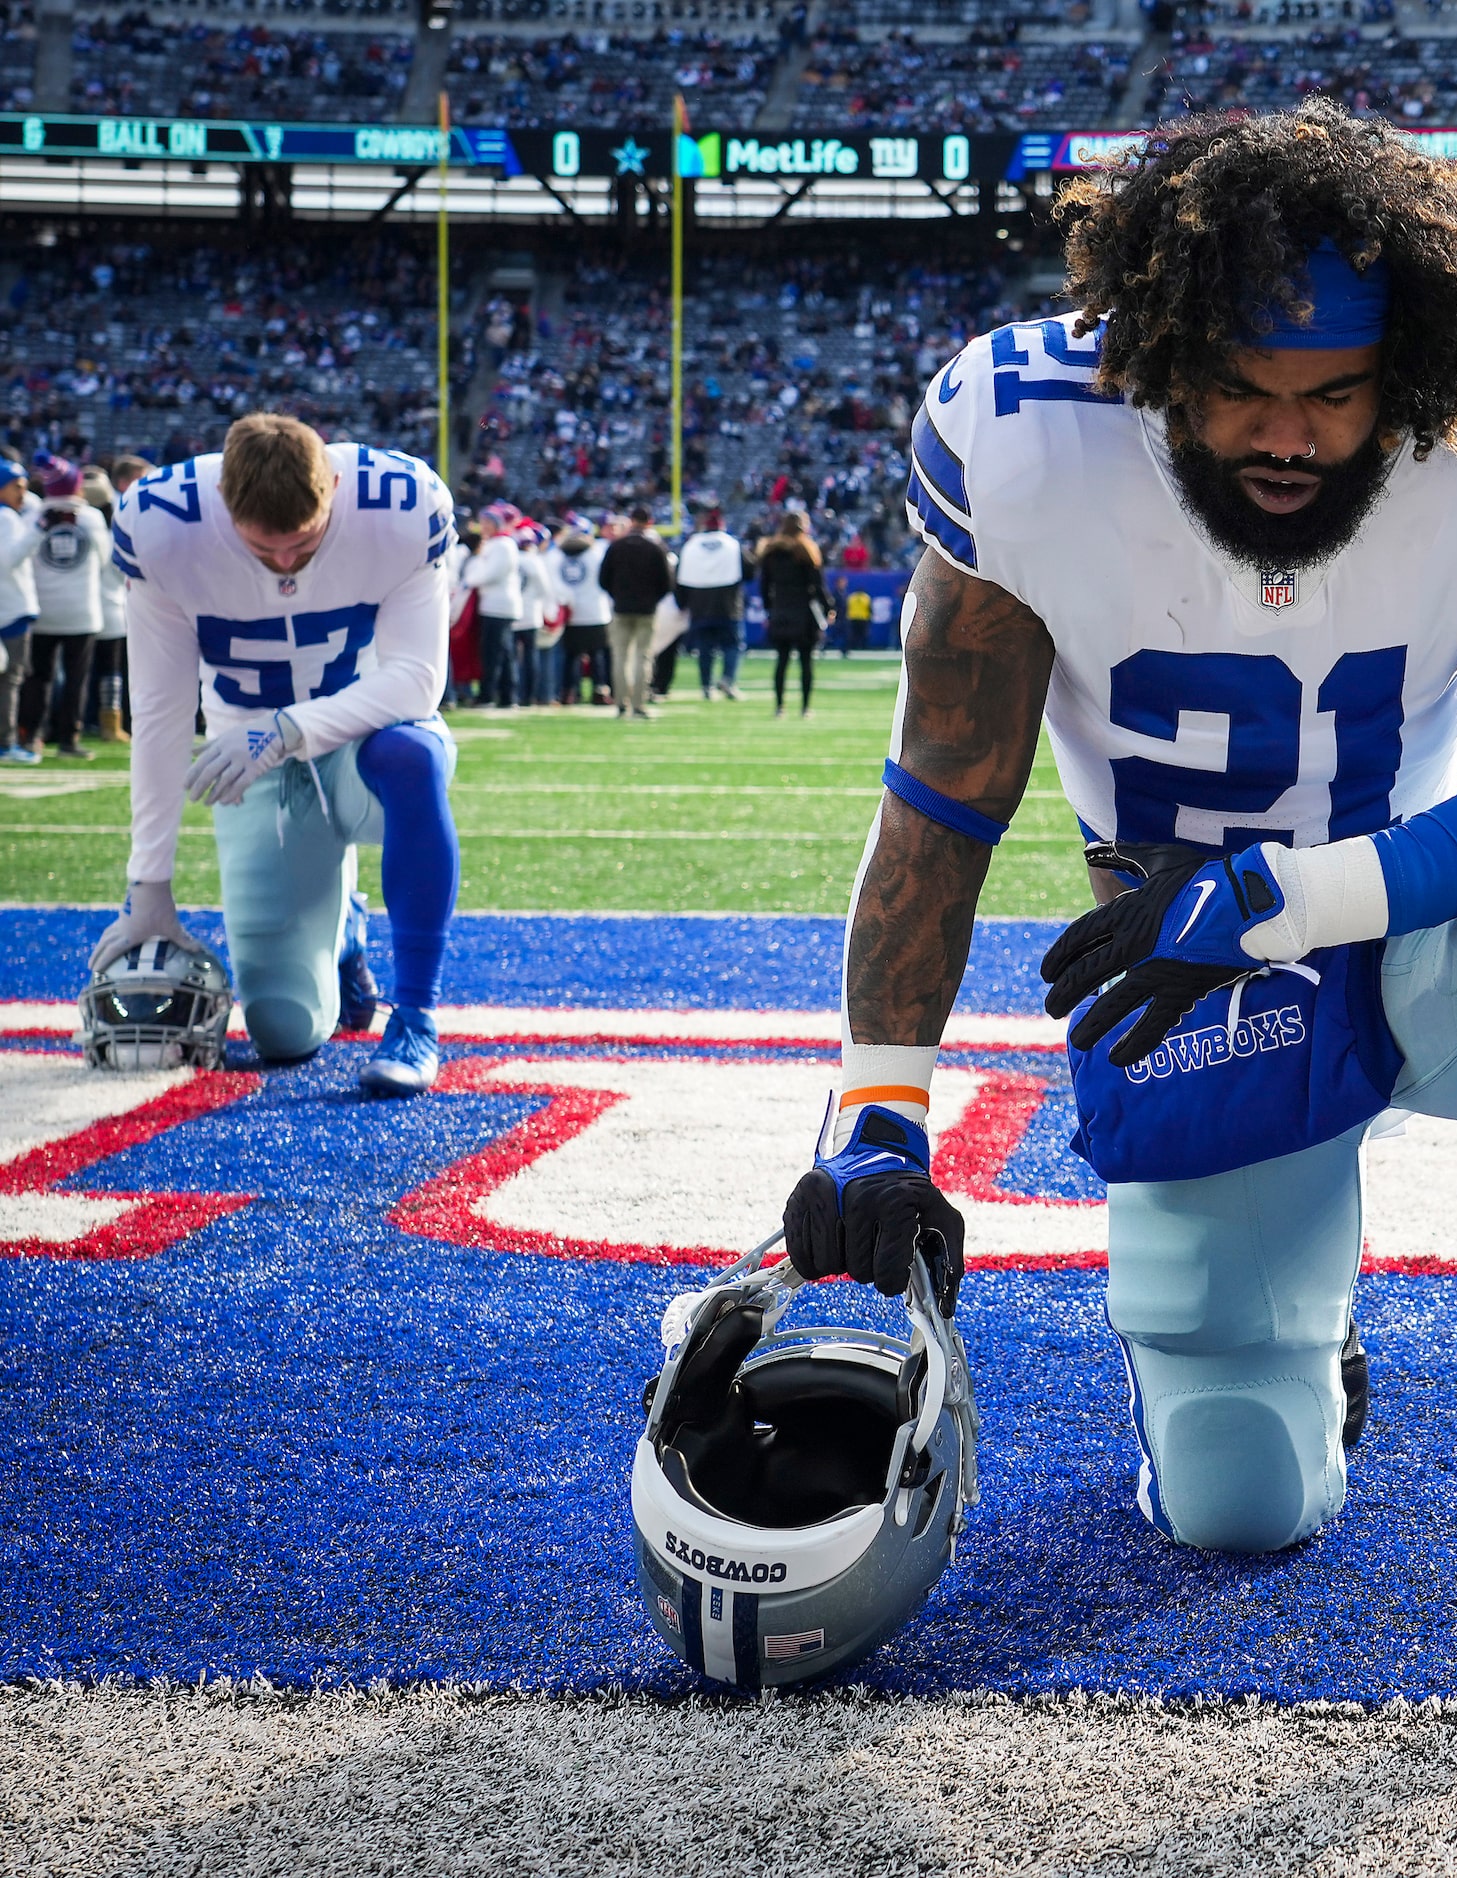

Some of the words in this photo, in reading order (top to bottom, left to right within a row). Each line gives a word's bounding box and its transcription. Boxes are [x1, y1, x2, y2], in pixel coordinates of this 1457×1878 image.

[98, 119, 164, 154] BALL
[168, 122, 207, 156] ON
[726, 138, 859, 174] MetLife
[1263, 586, 1293, 606] NFL
[197, 603, 379, 709] 57
[1108, 644, 1409, 855] 21
[1124, 1004, 1306, 1084] COWBOYS
[665, 1530, 788, 1584] COWBOYS
